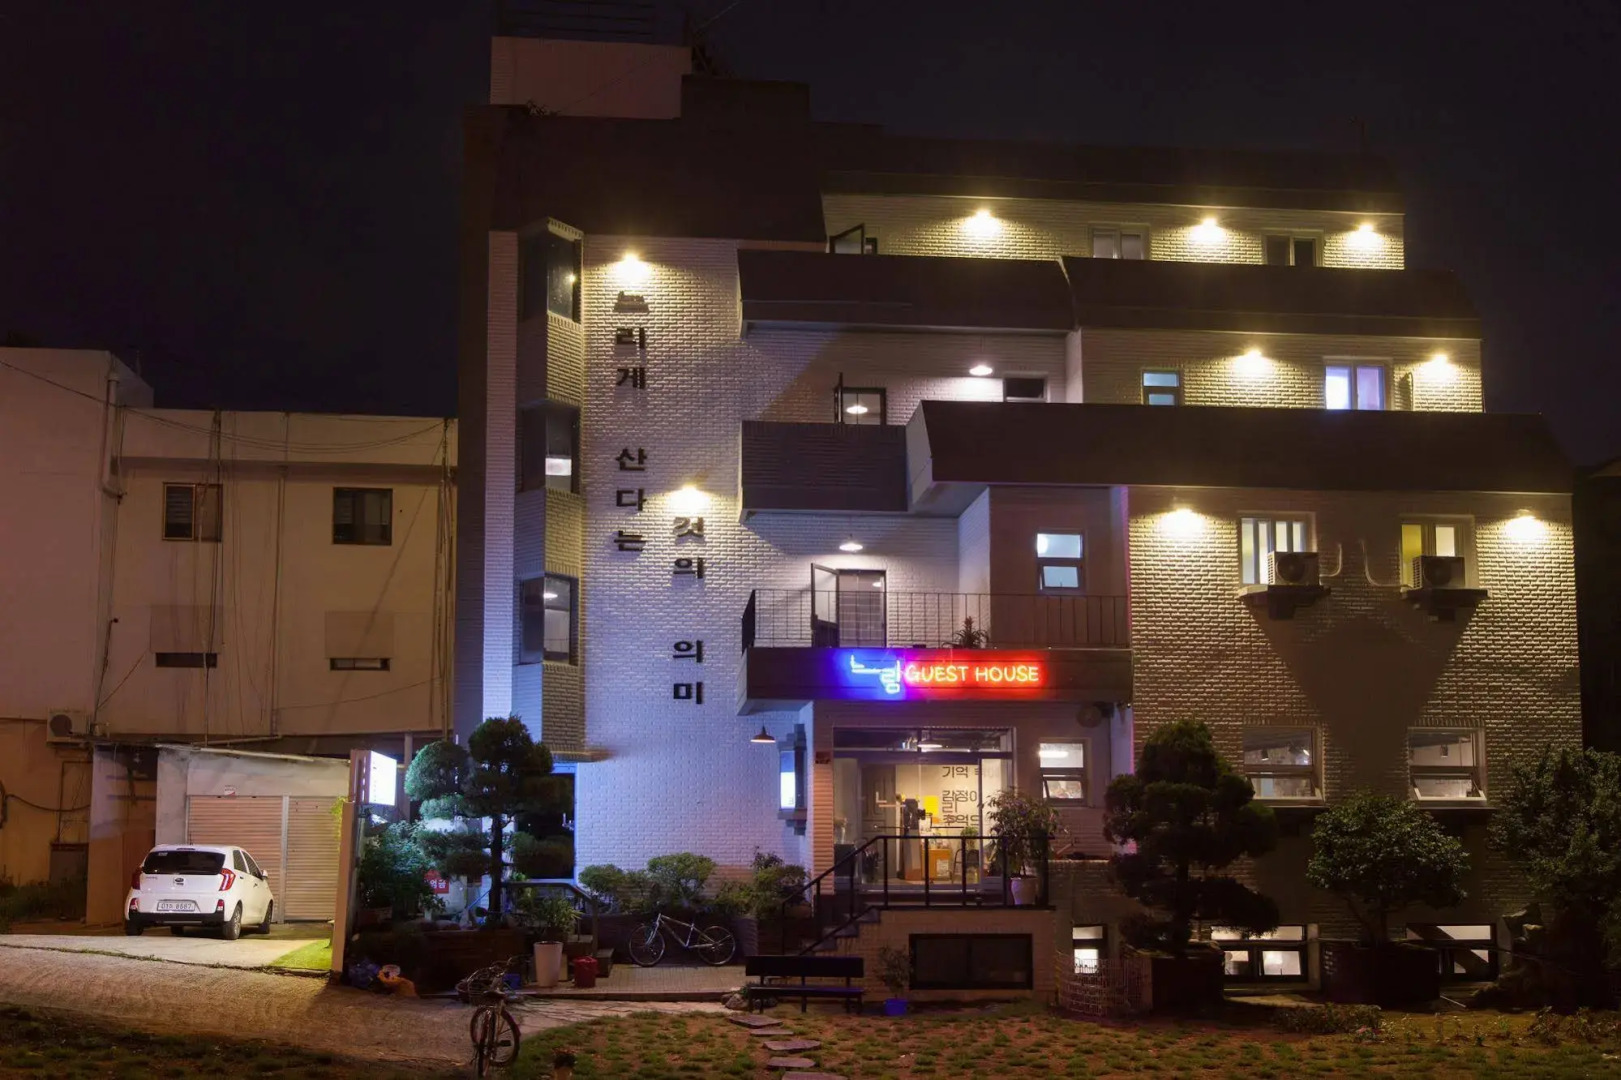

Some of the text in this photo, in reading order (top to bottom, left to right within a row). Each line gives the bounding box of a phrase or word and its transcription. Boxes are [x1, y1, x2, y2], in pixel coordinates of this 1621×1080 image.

[614, 291, 647, 551] 느리게 산다는
[673, 517, 705, 705] 것의 의미
[904, 664, 1040, 683] GUEST HOUSE
[942, 766, 969, 779] 기억
